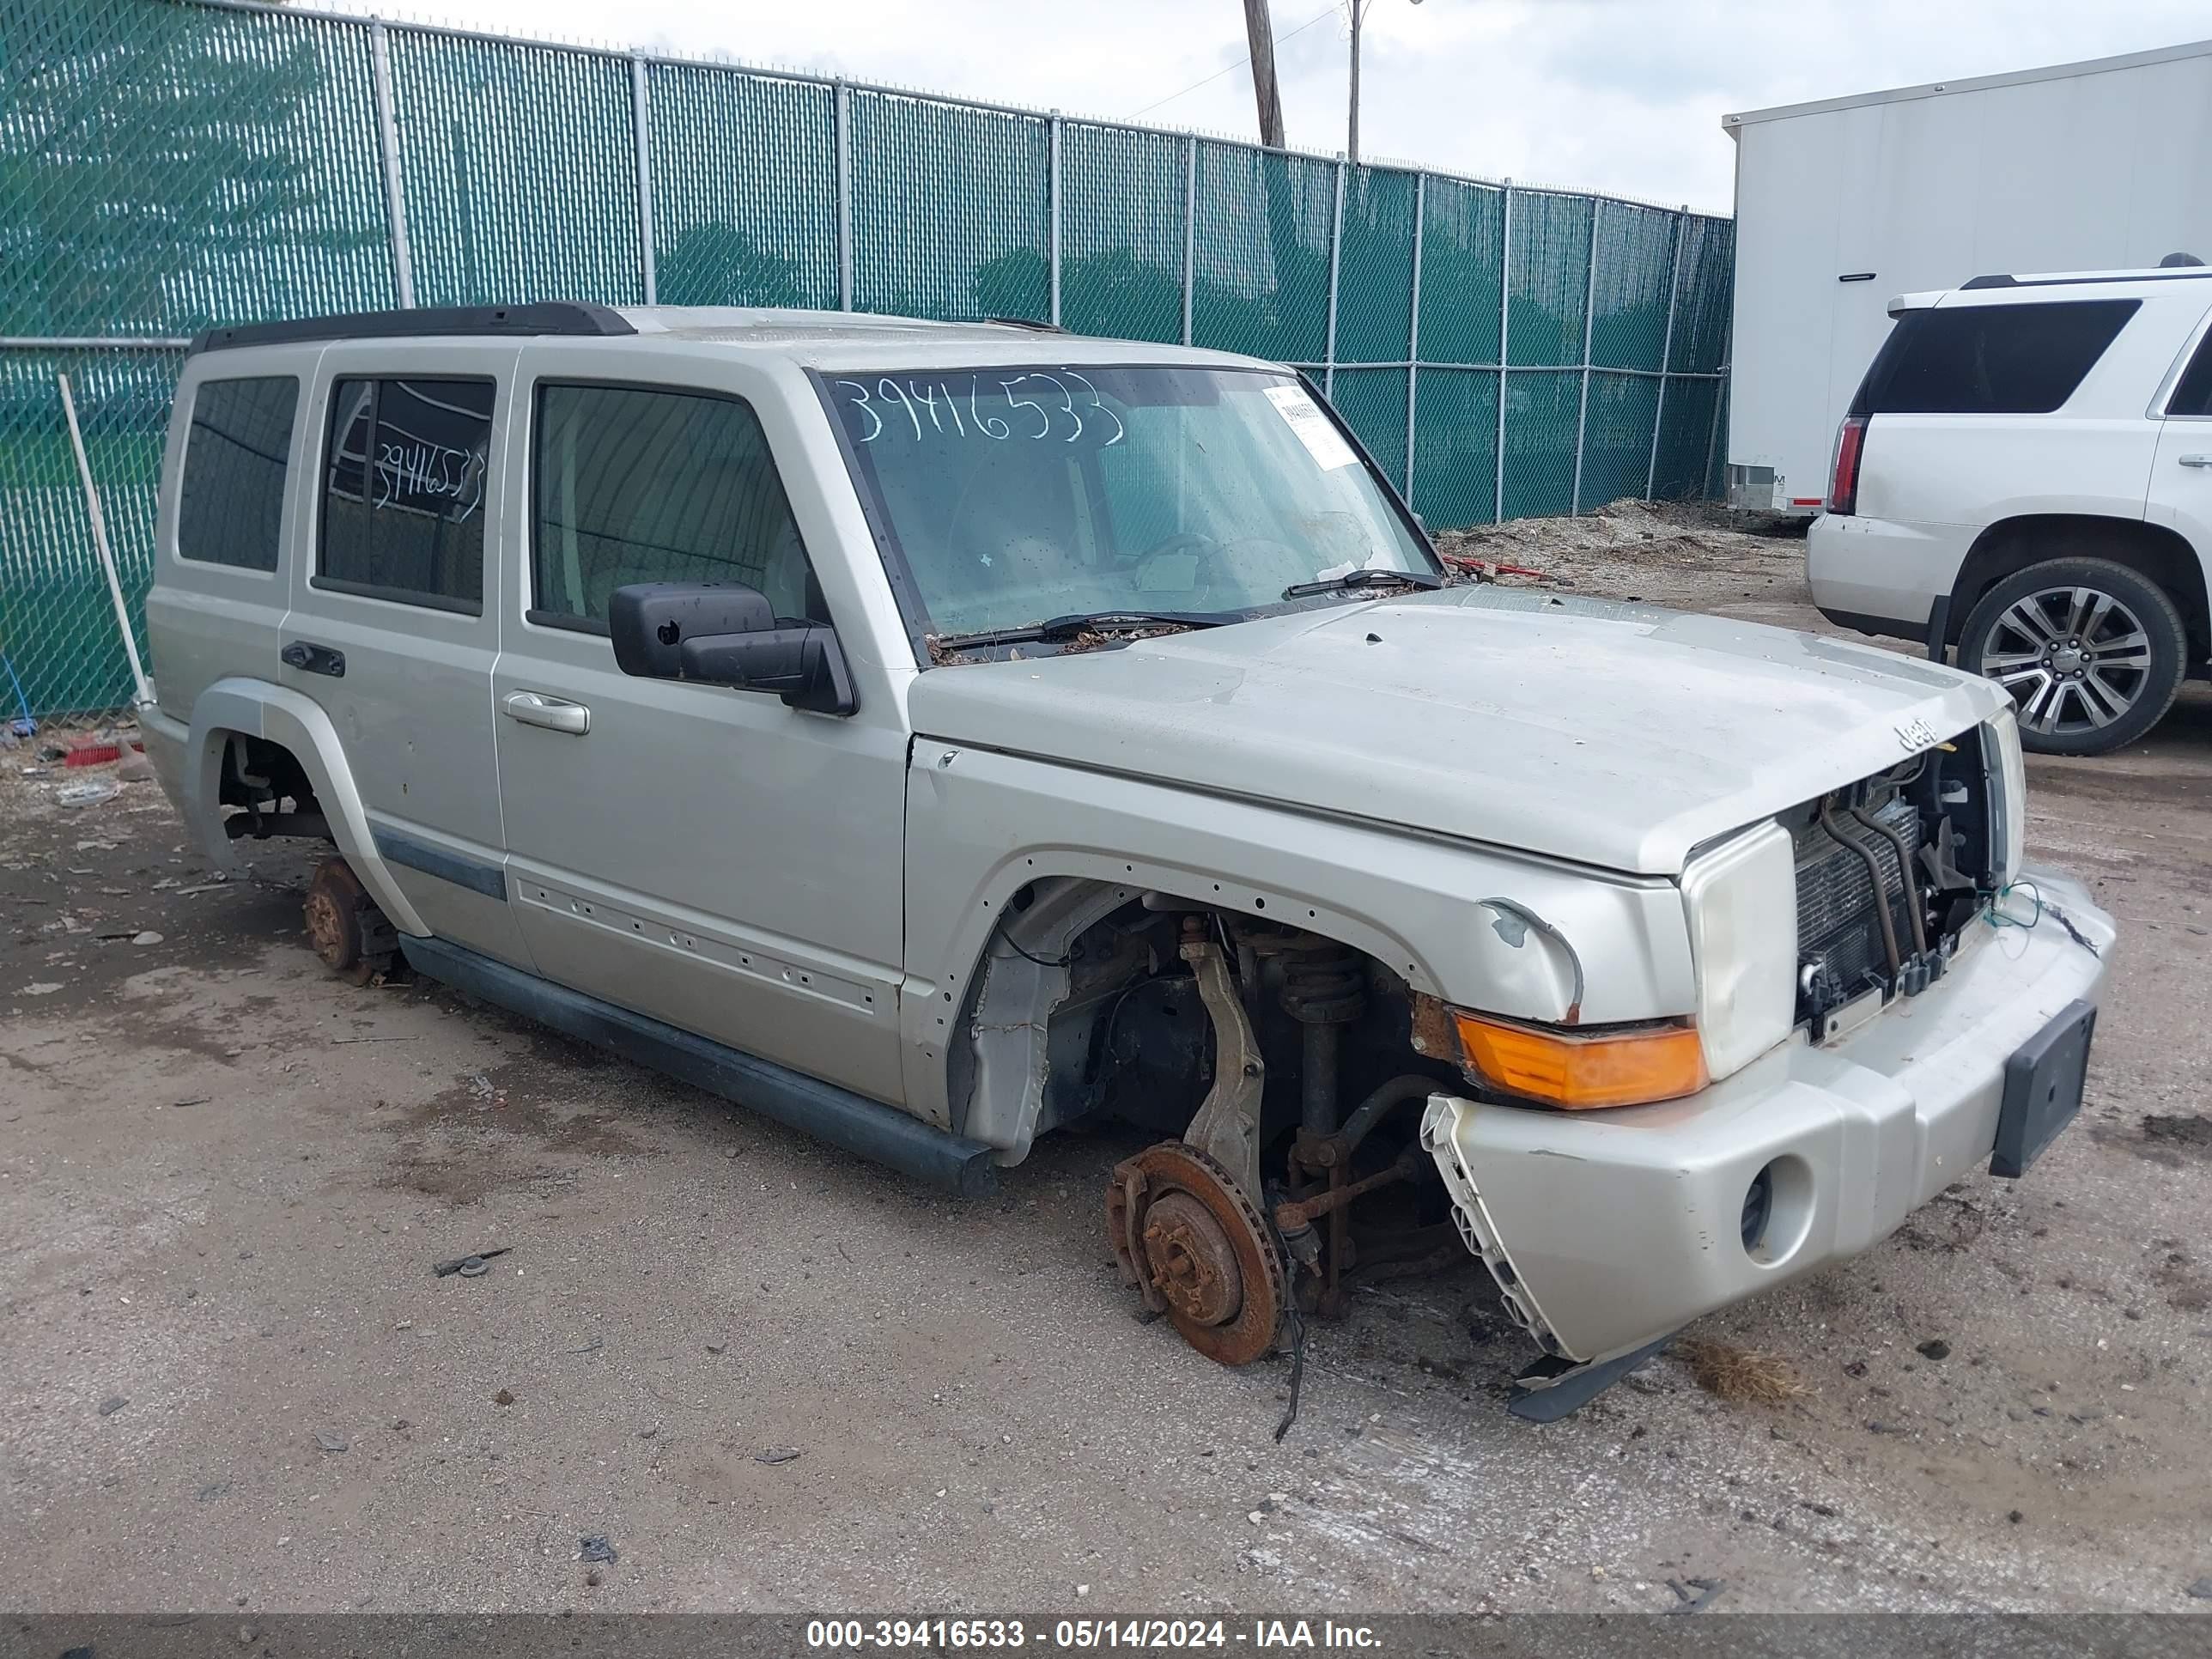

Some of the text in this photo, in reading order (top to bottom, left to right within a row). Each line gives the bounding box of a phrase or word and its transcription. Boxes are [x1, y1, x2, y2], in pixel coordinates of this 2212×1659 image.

[836, 372, 1123, 446] 39416533
[376, 443, 486, 524] 39416533
[1893, 718, 1938, 753] Jeep
